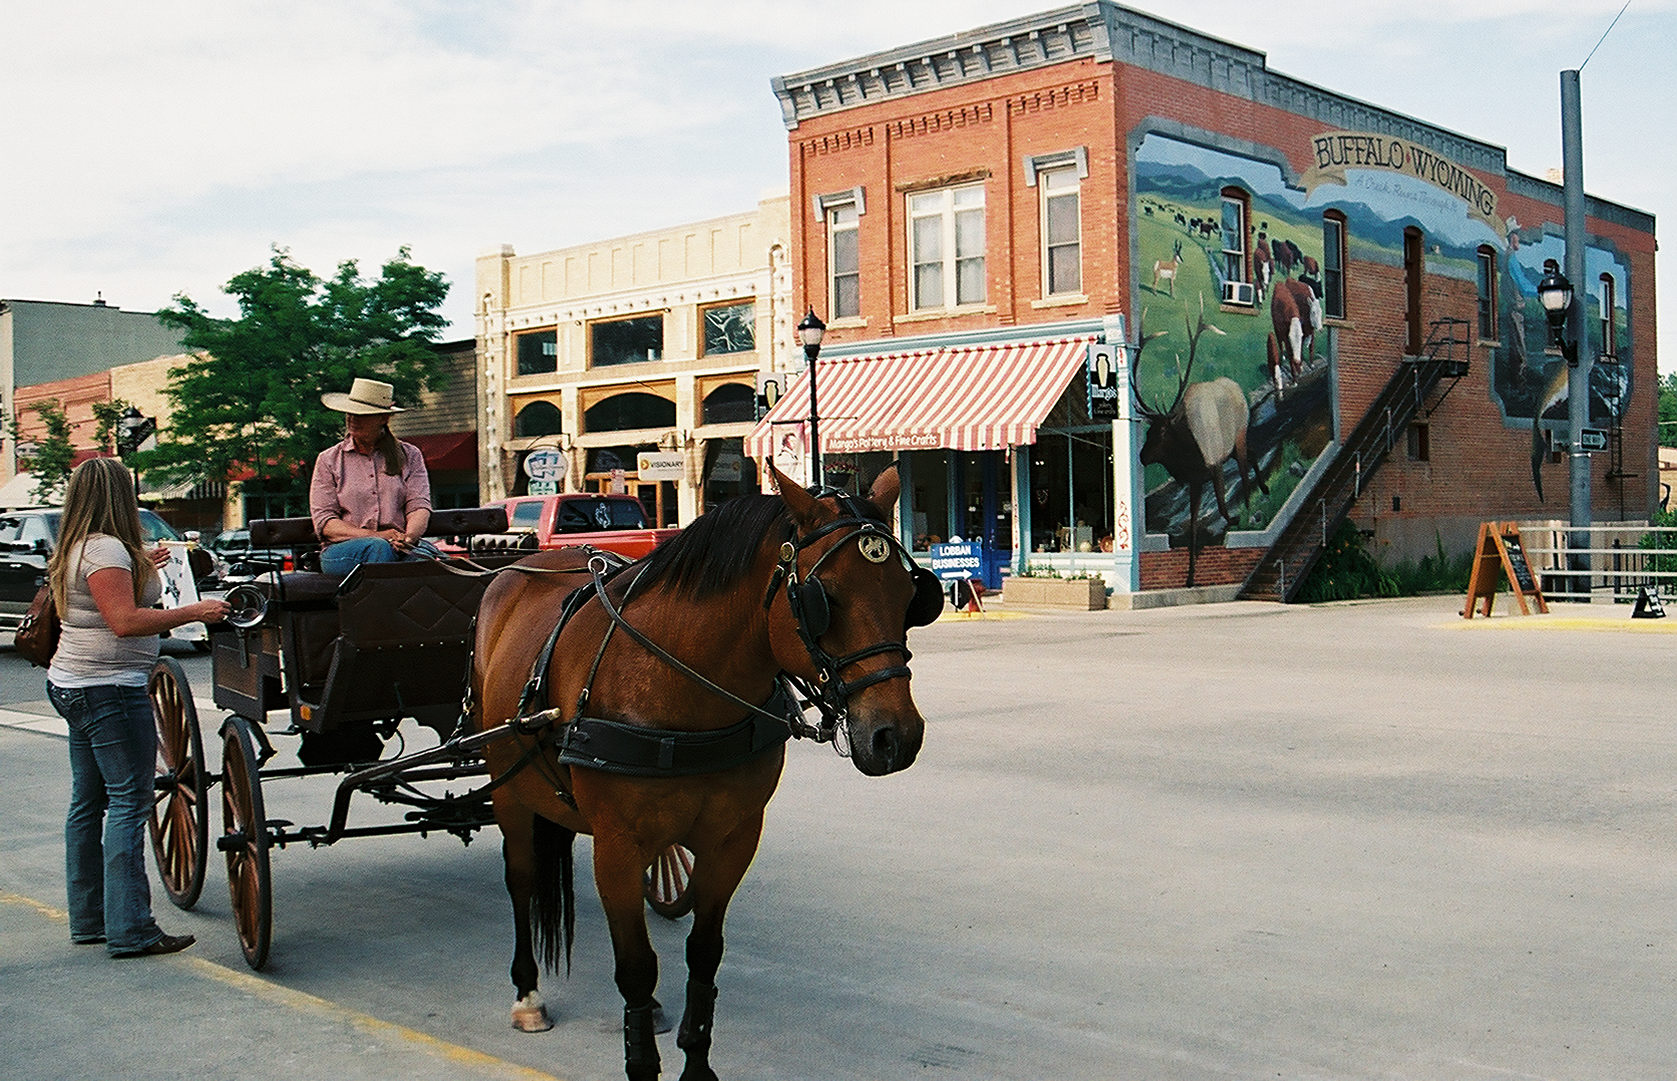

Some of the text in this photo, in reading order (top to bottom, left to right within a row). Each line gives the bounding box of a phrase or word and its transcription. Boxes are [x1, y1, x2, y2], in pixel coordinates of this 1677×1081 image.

[1314, 136, 1494, 216] BUFFALO WYOMING
[859, 437, 888, 450] Pottery
[888, 435, 894, 446] &
[895, 435, 910, 446] Fine
[911, 433, 937, 446] Crafts
[939, 545, 971, 557] LOBBAN
[932, 557, 980, 570] BUSINESSES
